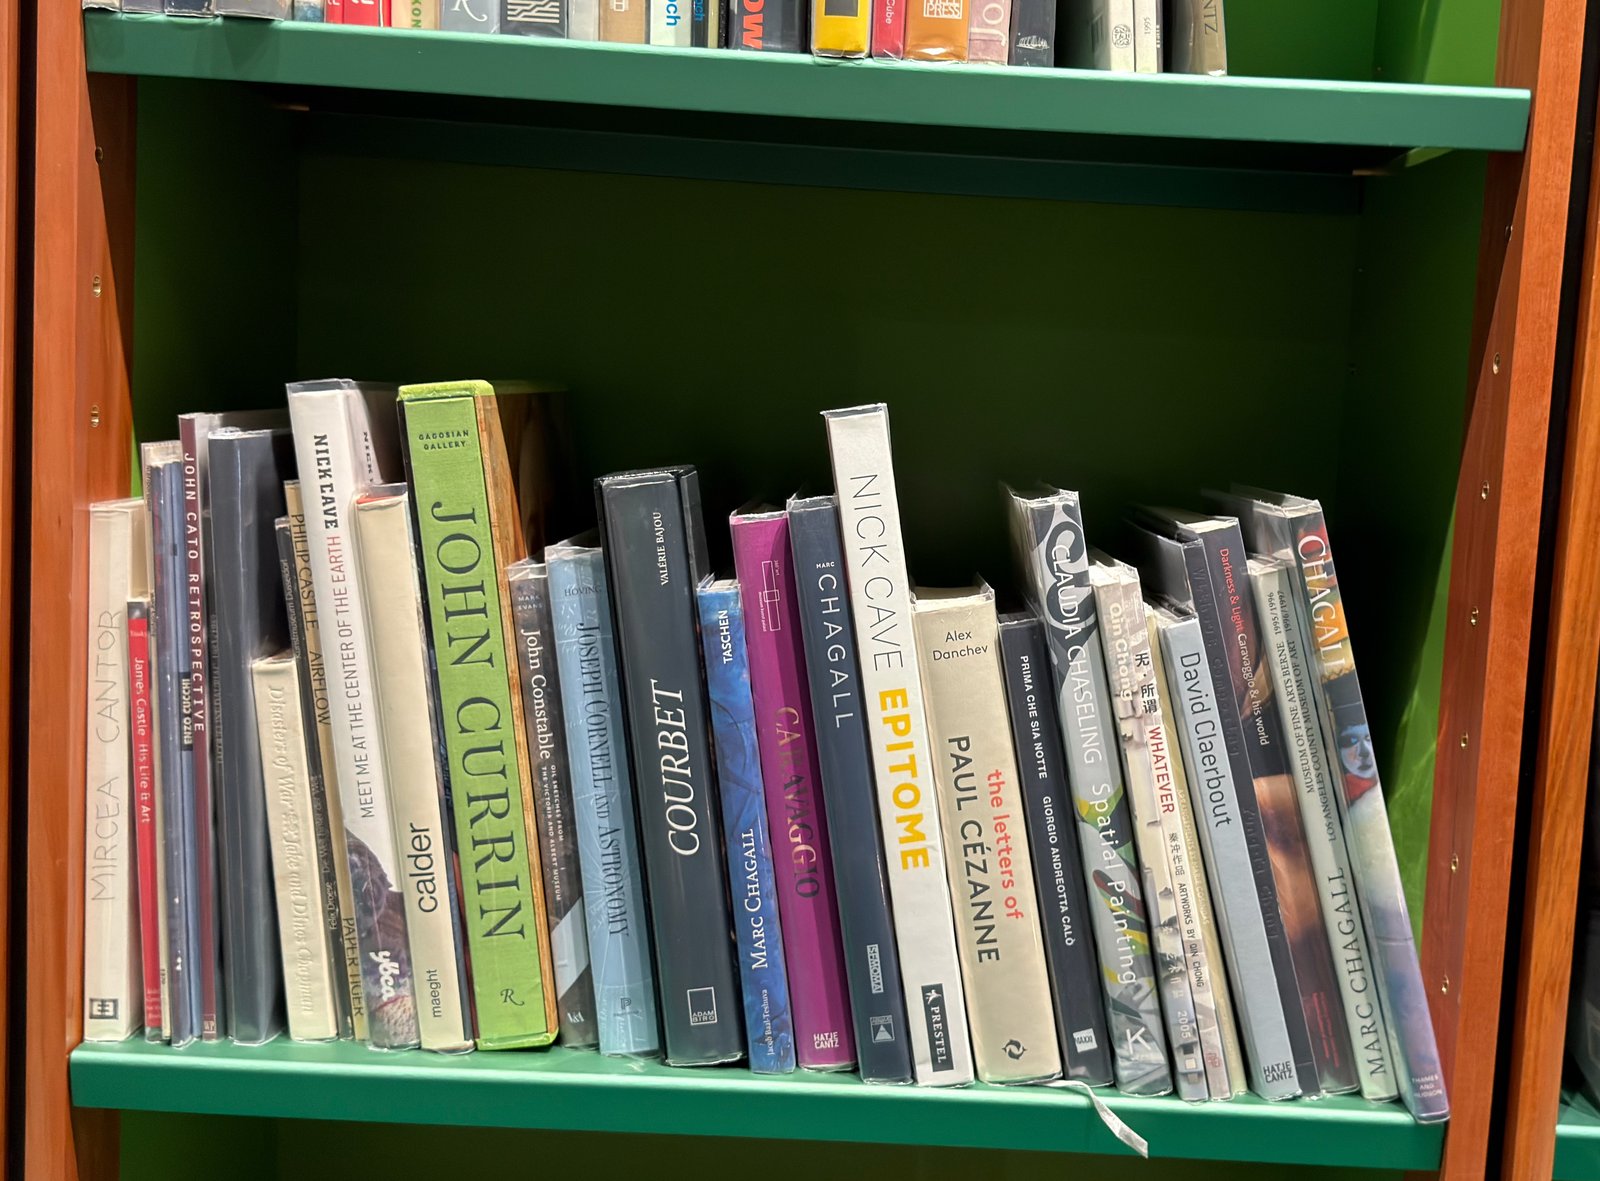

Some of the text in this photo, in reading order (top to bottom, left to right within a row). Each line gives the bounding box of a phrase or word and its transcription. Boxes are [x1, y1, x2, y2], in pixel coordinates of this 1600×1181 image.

[926, 4, 961, 17] PRESS
[418, 429, 470, 440] GAGOSIAN
[423, 440, 467, 450] GALLERY
[313, 434, 339, 529] NICK CAVE
[652, 512, 670, 586] VALÉRIE BAJOU
[816, 561, 835, 569] MARC
[184, 451, 205, 733] JOHN CATO RETROSPECTIVE
[563, 586, 602, 597] HOVING
[1298, 534, 1346, 671] CHAGALL
[291, 513, 331, 726] PHILIP CASTLE AIRFLOW
[718, 610, 733, 664] TASCHEN
[945, 629, 973, 643] Alex
[817, 573, 854, 729] CHAGALL
[850, 474, 931, 870] NICK CAVE EPITOME
[932, 643, 989, 662] Danchev
[1115, 638, 1134, 702] Chong
[1219, 548, 1236, 595] Darkness
[1237, 633, 1256, 688] Caravaggio
[1254, 715, 1270, 746] world
[1286, 638, 1297, 660] ART
[1291, 661, 1302, 680] OF
[133, 656, 146, 694] James
[325, 535, 375, 818] MEET ME AT THE CENTER OF THE EARTH
[520, 628, 555, 760] John Constable
[1180, 652, 1212, 716] David
[1266, 591, 1315, 793] MUSEUM OF FINE ARTS BERNE 1995/1996
[135, 698, 148, 736] Castle
[182, 678, 192, 744] ENZO CUCCHI
[266, 687, 290, 751] Disasters
[430, 501, 526, 940] JOHN CURRIN
[1295, 681, 1311, 724] MUSEUM
[90, 609, 123, 901] MIRCEA CANTOR
[138, 743, 149, 761] His
[272, 754, 290, 773] of
[649, 678, 701, 857] COURBET
[1051, 544, 1137, 985] CLAUDIA CHASELING Spatial Painting
[1148, 726, 1175, 814] WHATEVER
[1194, 718, 1233, 828] Claerbout
[1304, 724, 1321, 771] COUNTY
[138, 765, 150, 788] Life
[543, 783, 552, 818] VICTORIA
[552, 780, 560, 817] SKETCHES
[577, 622, 630, 938] JOSEPH CORNELL AND ASTRONOMY
[774, 705, 821, 898] CARAVAGGIO
[1020, 655, 1076, 947] PRIMA CHE SIA NOTTE GIORGIO ANDREOTTA CALÒ
[1314, 771, 1331, 817] ANGELES
[140, 805, 151, 822] Art
[284, 836, 302, 869] Jake
[407, 821, 438, 914] calder
[549, 838, 557, 865] ALBERT
[947, 735, 1001, 964] PAUL CÉZANNE
[986, 768, 1024, 920] the letters of
[290, 872, 307, 898] and
[324, 881, 335, 910] Droese
[552, 869, 561, 901] MUSEUM
[741, 828, 769, 970] MARC CHAGALL
[1177, 882, 1193, 926] ARTWORKS
[1186, 927, 1195, 940] BY
[1192, 959, 1205, 988] CHONG
[295, 946, 314, 1014] Chapman
[342, 917, 365, 1017] PAPER TIGER
[369, 950, 400, 1003] ybca
[424, 968, 442, 1018] maeght
[1327, 866, 1387, 1077] MARC CHAGALL
[692, 1009, 716, 1018] ADAM
[692, 1015, 716, 1023] BIRO
[813, 1032, 839, 1042] HATJE
[930, 1006, 948, 1065] PRESTEL
[1177, 1010, 1191, 1039] 2005
[814, 1040, 840, 1050] CANTZ
[1126, 1027, 1152, 1054] K
[1263, 1061, 1292, 1076] HATJE
[1265, 1070, 1294, 1084] CANTZ
